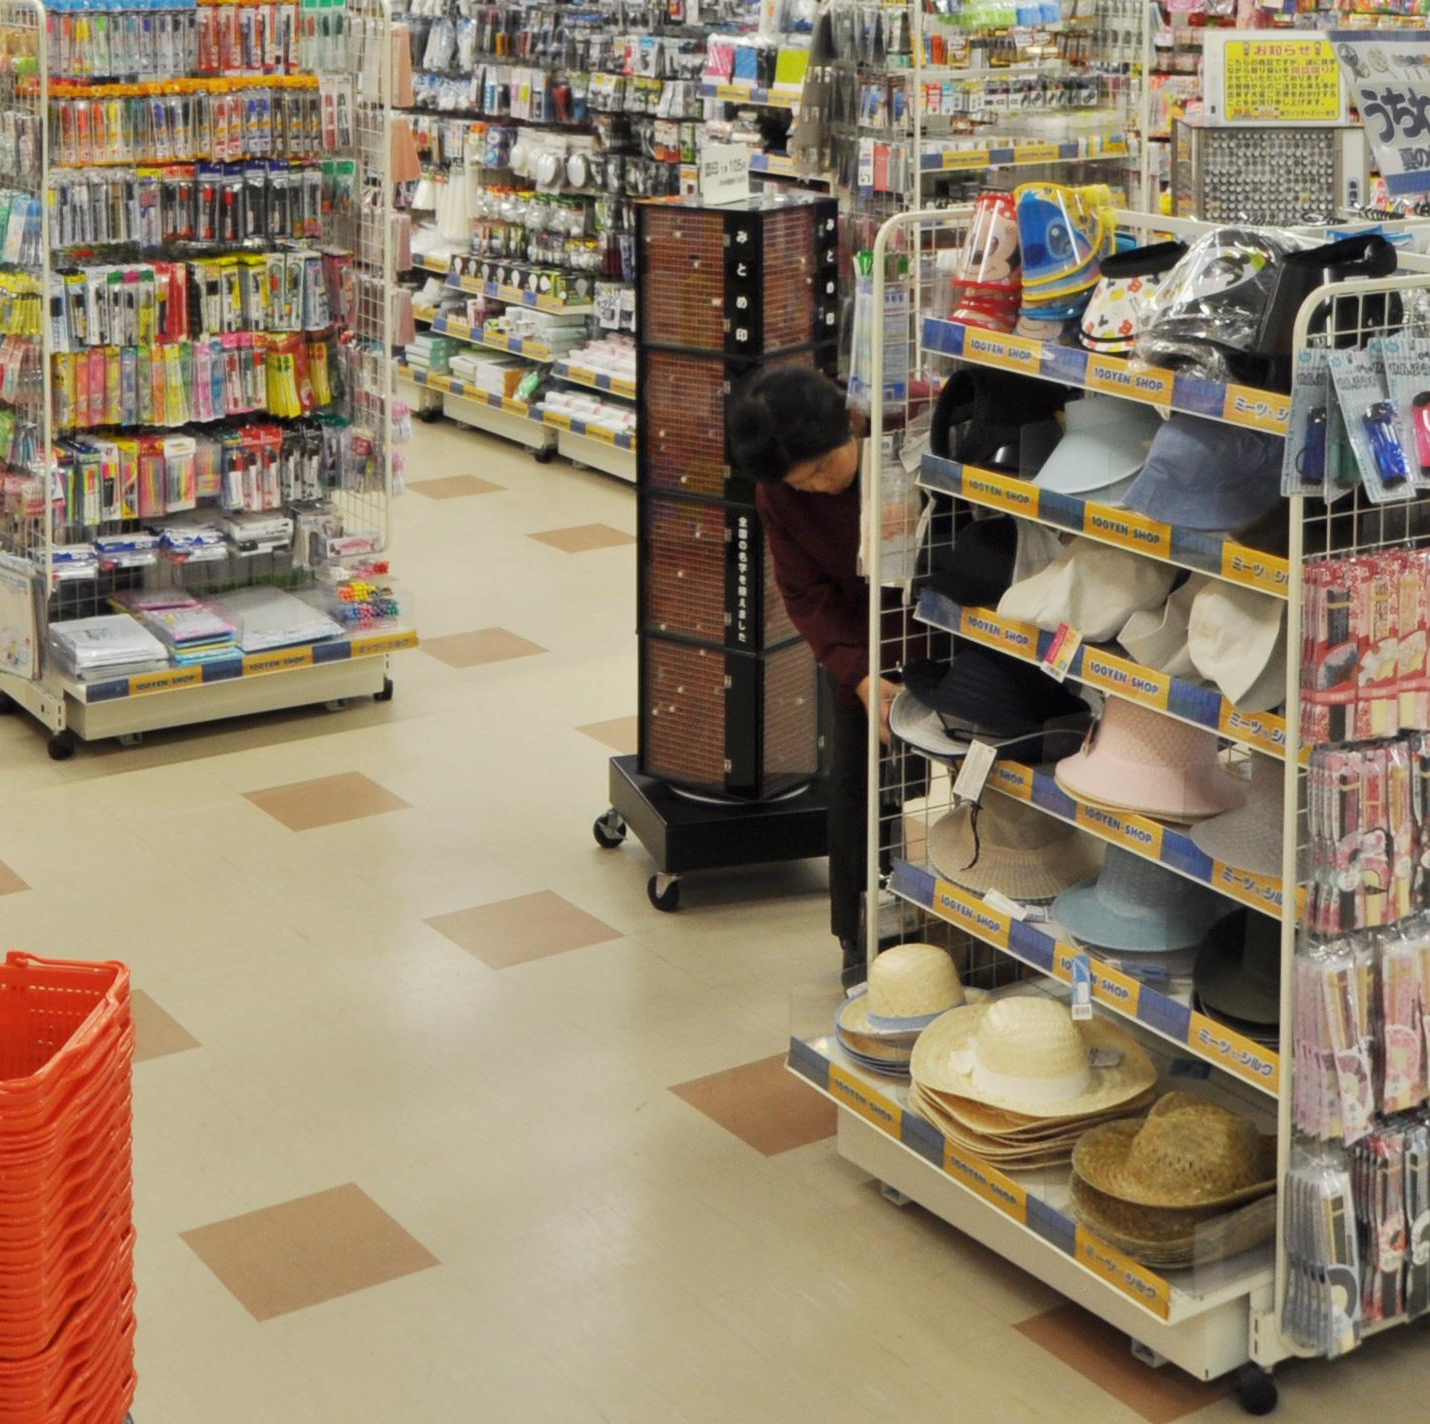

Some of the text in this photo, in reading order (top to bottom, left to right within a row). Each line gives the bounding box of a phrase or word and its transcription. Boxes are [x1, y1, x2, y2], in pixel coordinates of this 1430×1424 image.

[971, 340, 1032, 360] 100YEN SHOP
[1094, 367, 1164, 392] 100YEN SHOP
[969, 480, 1031, 504] 100YEN SHOP
[1091, 516, 1161, 545] 100YEN SHOP
[968, 616, 1030, 646] 100YEN SHOP
[1089, 661, 1160, 695] 100YEN SHOP
[1084, 806, 1153, 844] 100YEN SHOP
[940, 894, 1001, 934] 100YEN SHOP
[1100, 976, 1130, 1000] SHOP
